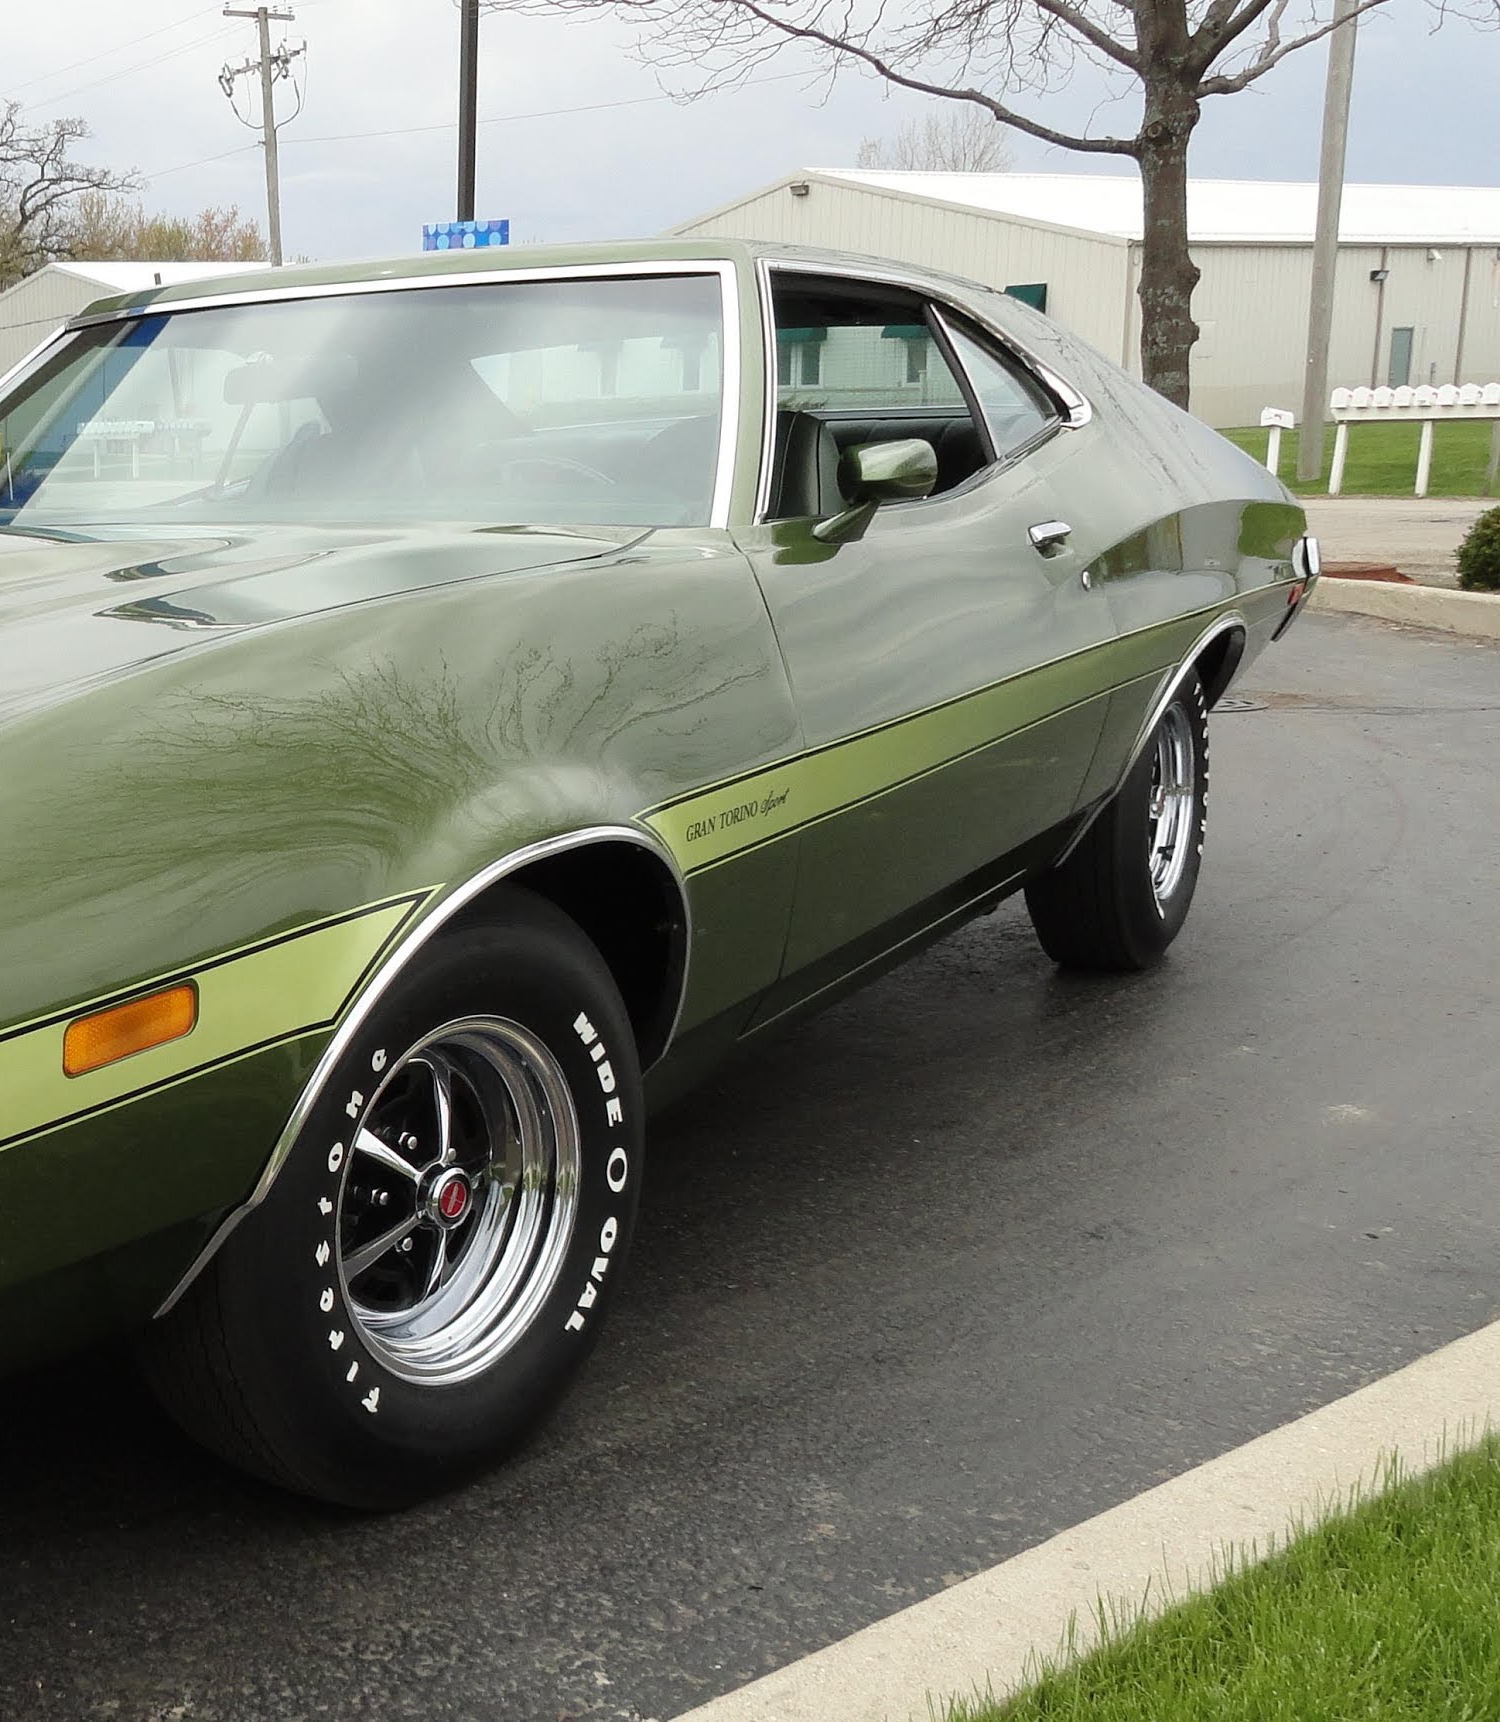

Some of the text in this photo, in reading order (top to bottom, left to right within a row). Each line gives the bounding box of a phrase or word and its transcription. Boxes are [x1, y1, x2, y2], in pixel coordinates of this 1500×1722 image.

[686, 816, 716, 842] GRAN
[720, 800, 758, 829] TORINO
[573, 1011, 624, 1127] WIDE
[564, 1216, 618, 1332] OVAL
